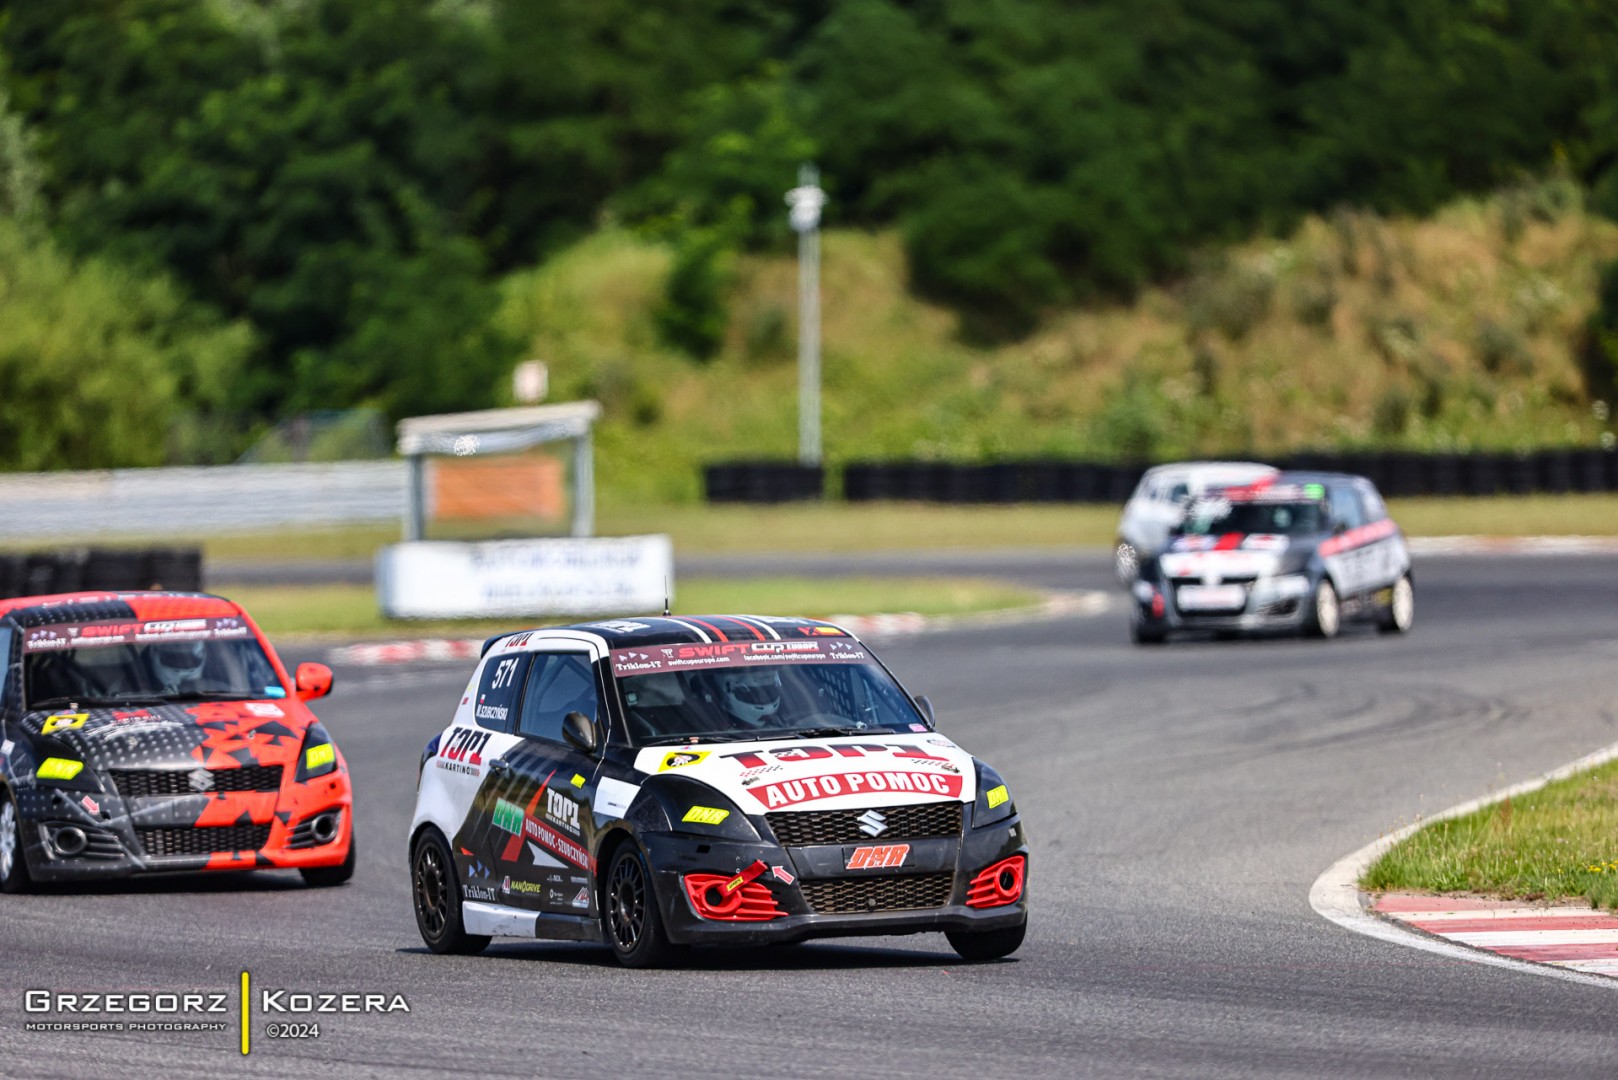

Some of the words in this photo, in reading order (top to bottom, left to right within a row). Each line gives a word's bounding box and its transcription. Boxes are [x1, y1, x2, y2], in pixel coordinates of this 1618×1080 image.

[81, 624, 144, 638] SWIFT
[678, 643, 750, 658] SWIFT
[751, 642, 785, 654] CUP
[829, 650, 865, 660] Triklon-IT
[616, 659, 661, 672] Triklon-IT
[668, 656, 730, 667] swiftcupeurope.com
[491, 657, 519, 690] 571
[440, 726, 492, 766] TOP1
[445, 762, 471, 775] KARTING
[765, 774, 843, 808] AUTO
[844, 772, 950, 796] POMOC
[988, 786, 1009, 807] DNR
[547, 787, 581, 830] TOP1
[686, 807, 728, 822] DNR
[525, 818, 538, 838] AUTO
[537, 825, 556, 848] POMOC
[845, 843, 911, 870] DNR
[462, 884, 496, 901] Triklon-IT
